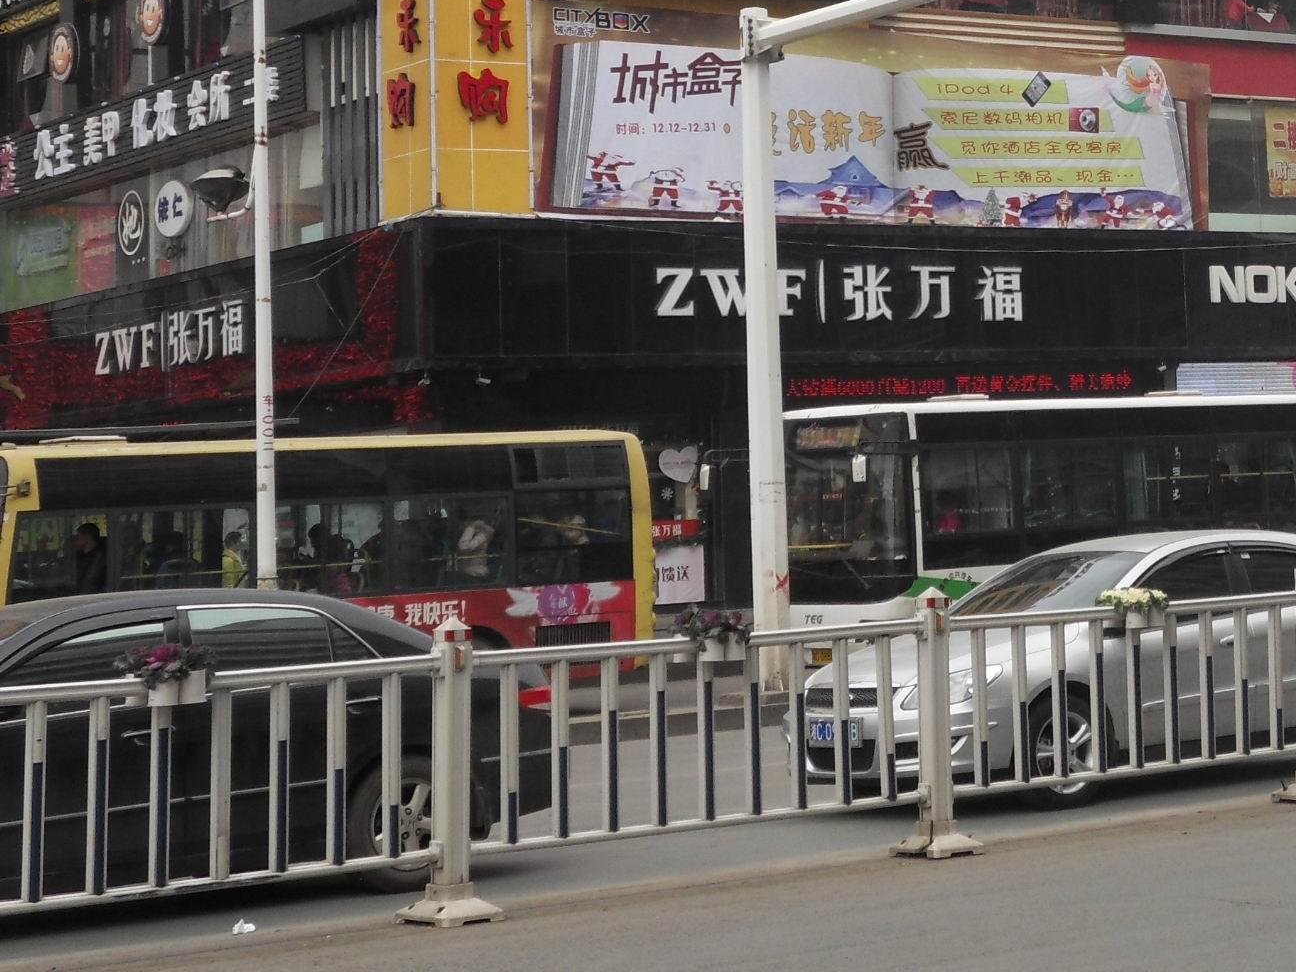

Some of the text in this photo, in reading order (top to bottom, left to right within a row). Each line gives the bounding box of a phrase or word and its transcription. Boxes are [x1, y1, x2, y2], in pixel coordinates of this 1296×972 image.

[999, 83, 1014, 95] 4
[83, 110, 120, 167] 美甲
[131, 89, 177, 150] 化妆
[186, 70, 231, 131] 会所
[940, 111, 1065, 125] 索尼数码相机
[653, 122, 716, 133] 12.12-12.31
[894, 120, 950, 171] 赢
[960, 141, 1122, 156] 觅你酒店全免客房
[843, 264, 1023, 322] 张万福
[95, 298, 245, 377] ZWF 张万福
[805, 614, 823, 625] TEG
